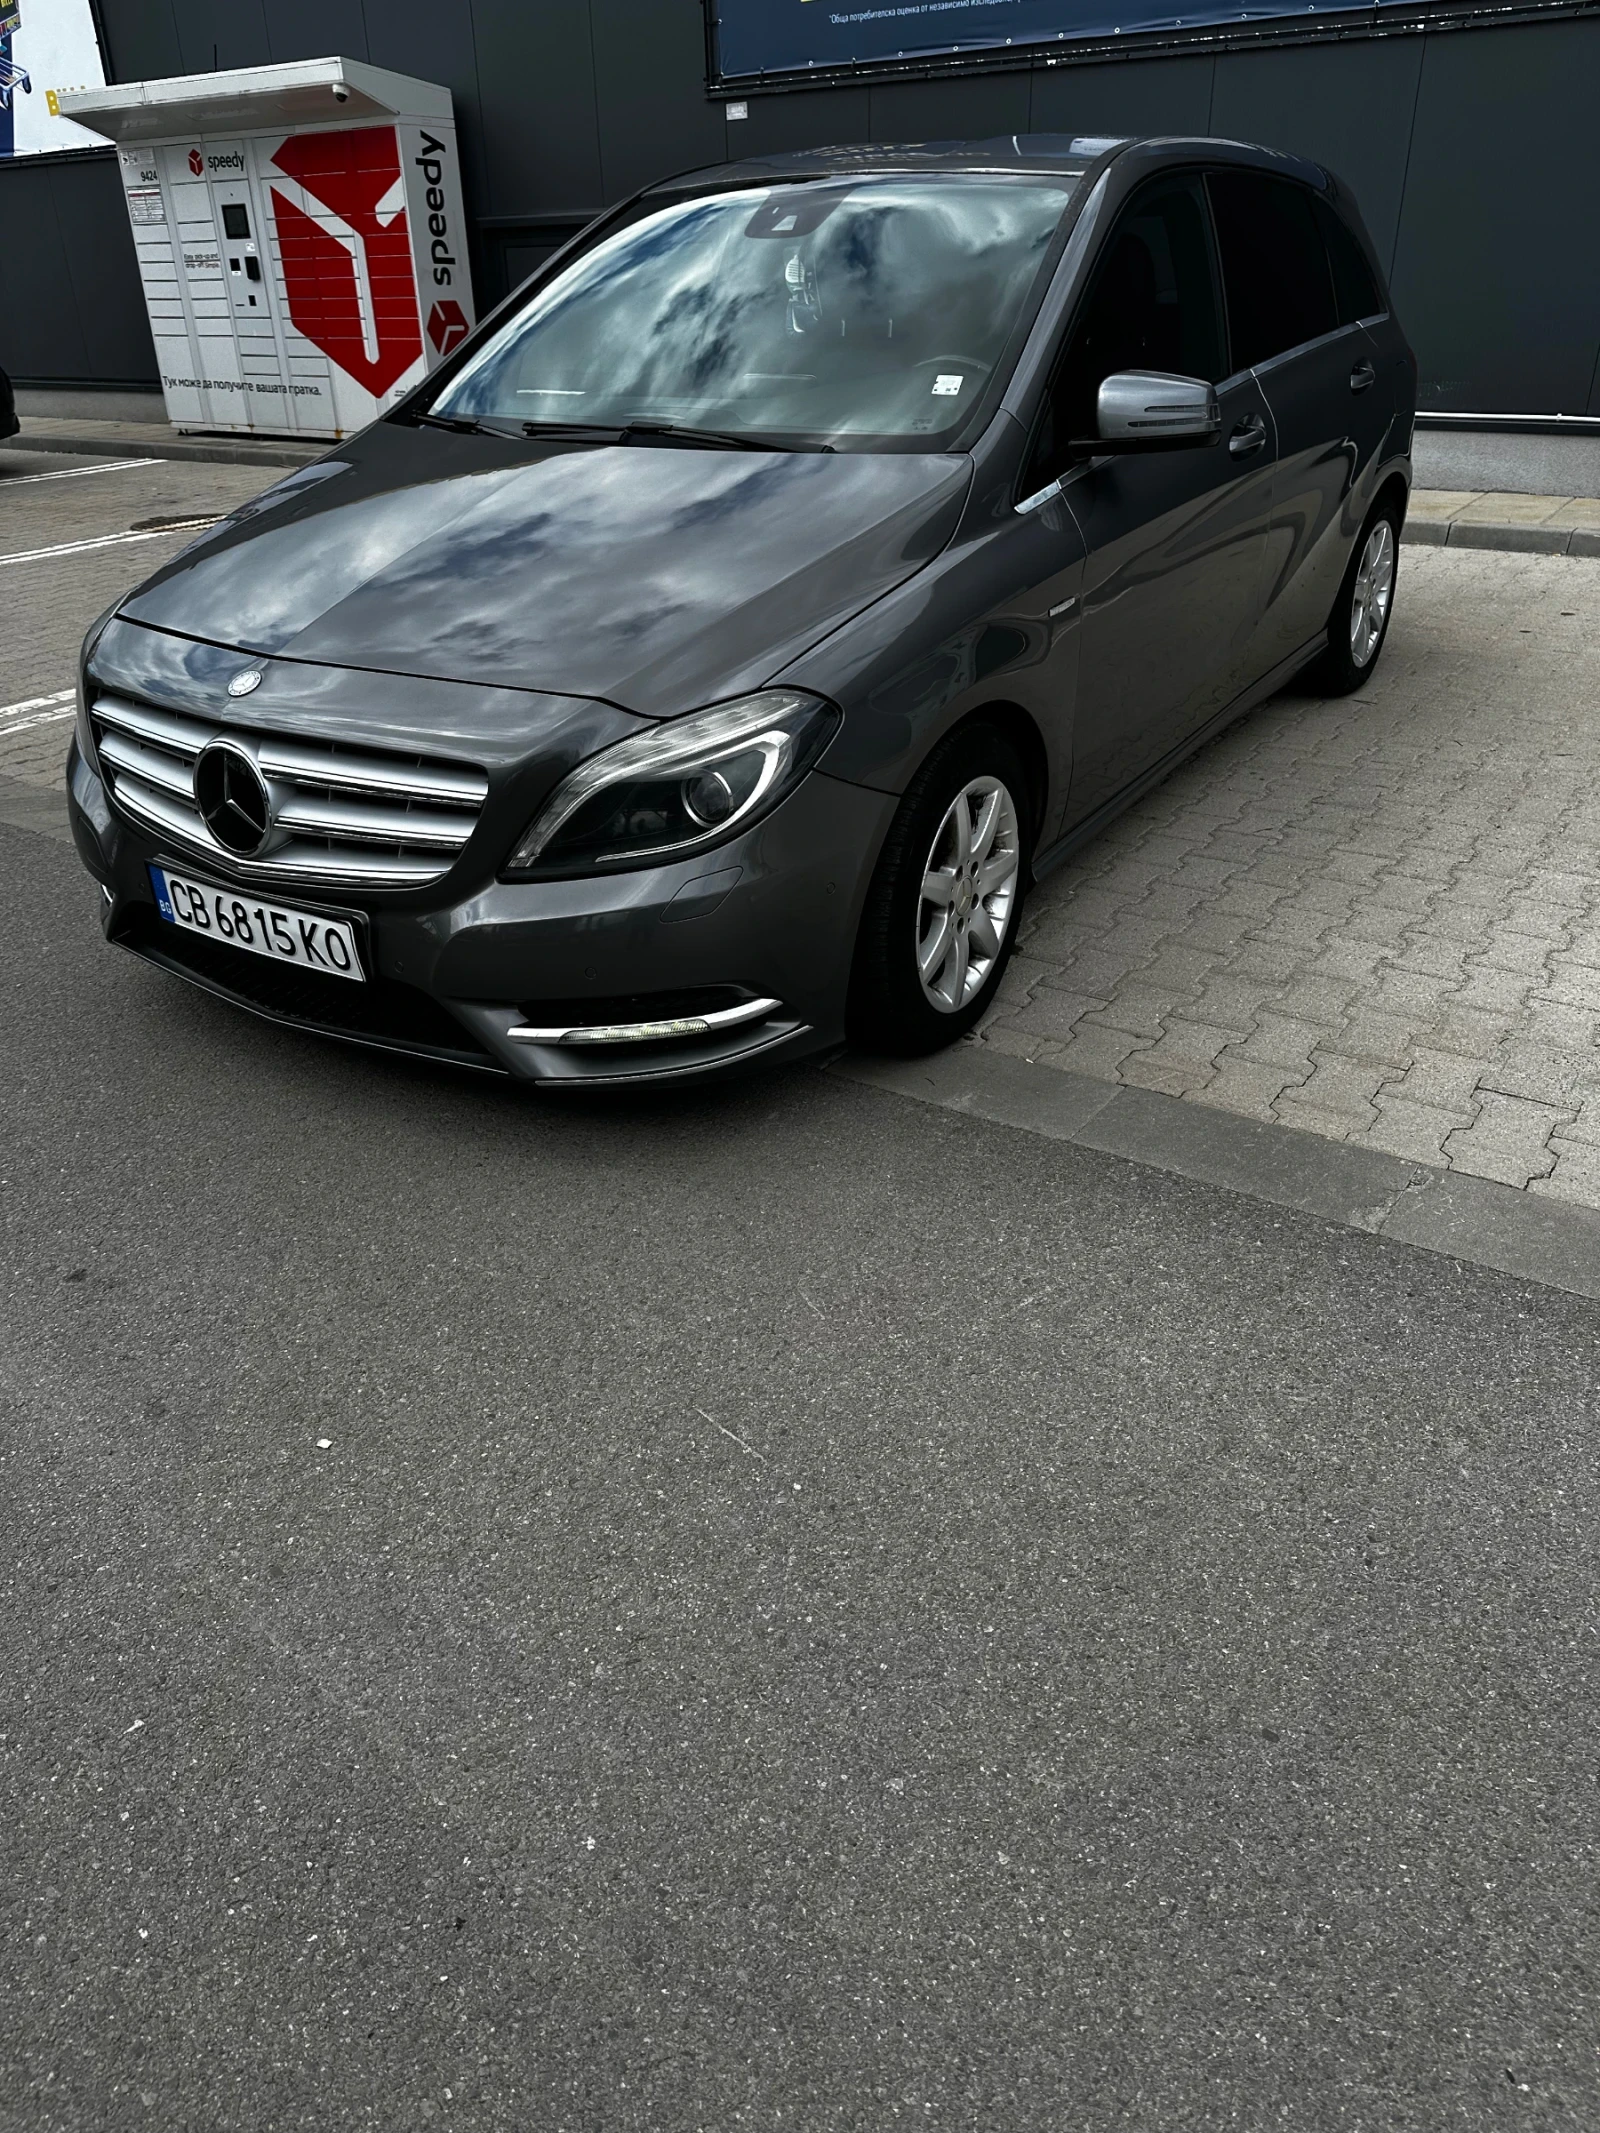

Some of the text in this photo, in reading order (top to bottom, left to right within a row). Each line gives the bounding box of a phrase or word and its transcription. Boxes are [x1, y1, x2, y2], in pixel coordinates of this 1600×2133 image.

[849, 8, 896, 23] потребителска
[897, 6, 920, 17] оценка
[921, 4, 929, 13] от
[929, 0, 969, 12] независимо
[208, 151, 244, 172] speedy
[140, 170, 158, 182] 9424
[415, 130, 456, 286] speedy
[162, 375, 322, 396] Тук може да получите вашата пратка.
[159, 900, 172, 914] BG
[169, 879, 211, 929] CB
[215, 895, 296, 957] 6815
